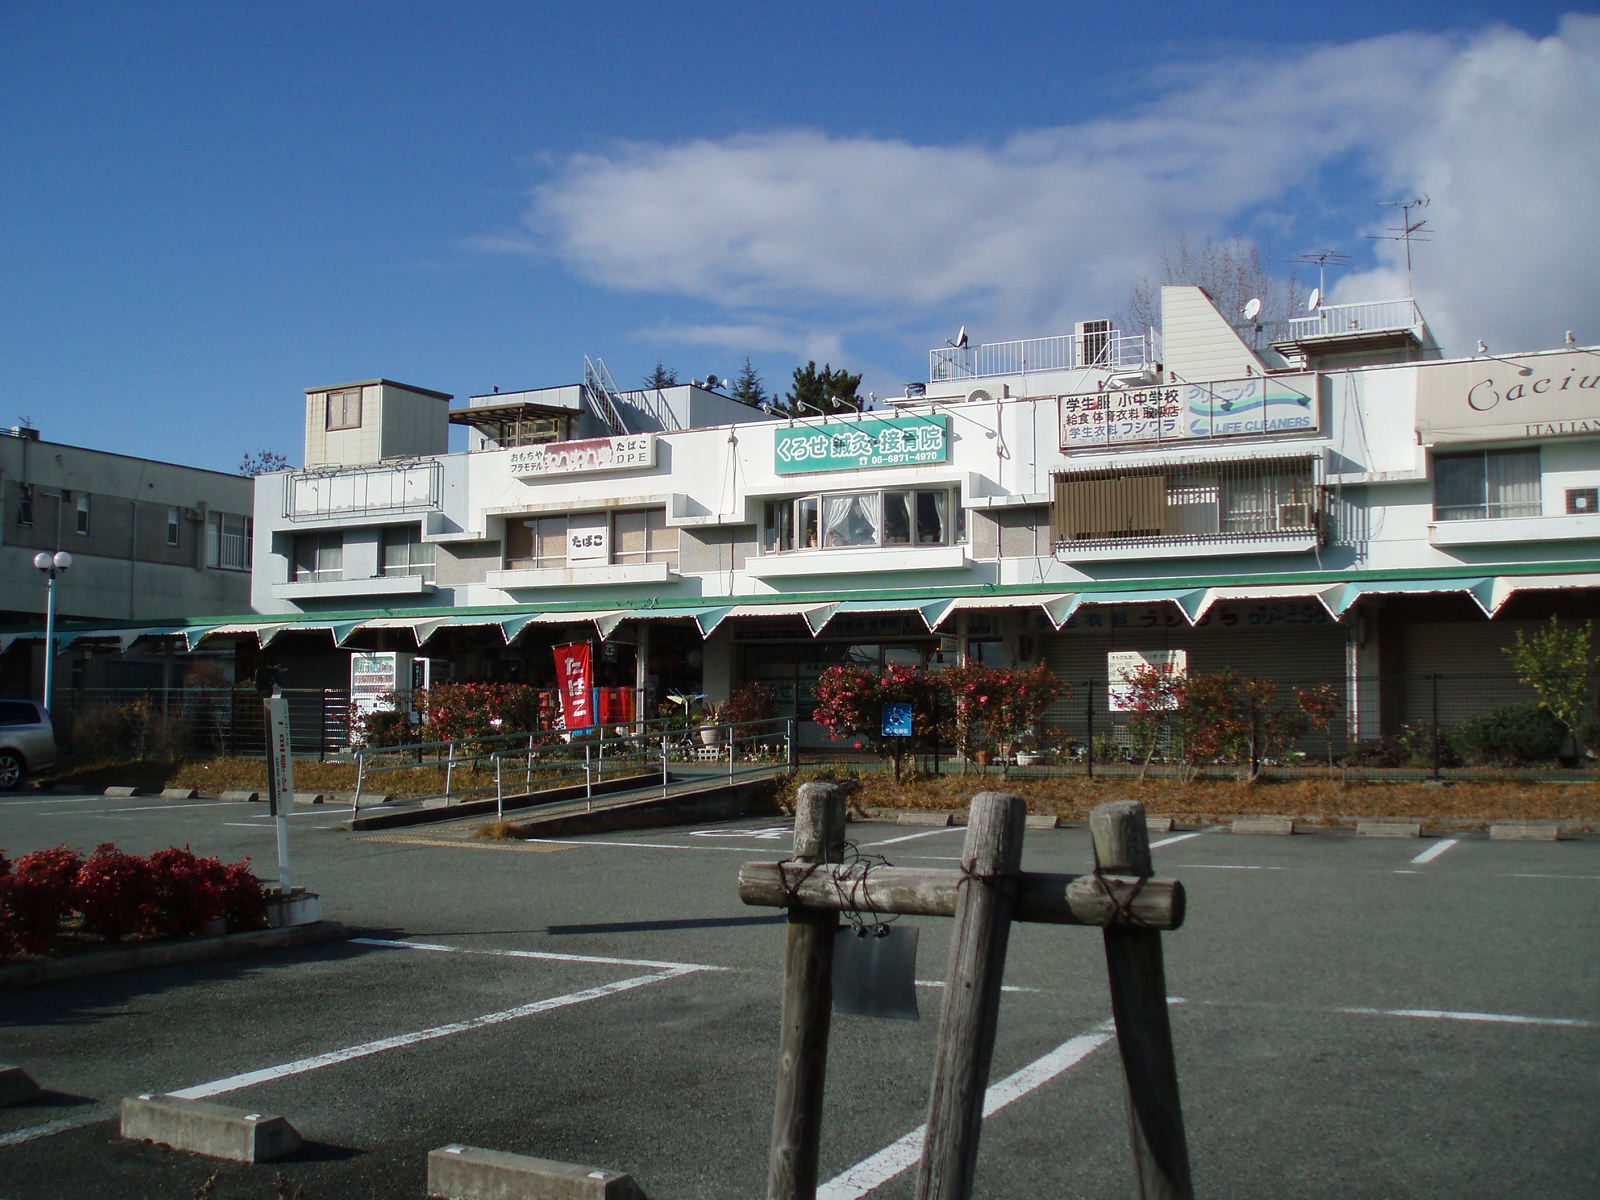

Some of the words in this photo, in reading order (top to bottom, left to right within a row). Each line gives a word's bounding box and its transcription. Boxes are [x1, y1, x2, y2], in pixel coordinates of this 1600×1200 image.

[1066, 394, 1111, 413] 学生服
[1118, 388, 1180, 408] 小中学校
[1066, 411, 1090, 427] 給食
[1215, 421, 1242, 435] LIFE
[1244, 415, 1311, 432] CLEANERS
[1069, 422, 1119, 440] 学生衣料
[1121, 418, 1177, 435] フジワラ
[616, 440, 647, 452] たばこ
[776, 435, 829, 463] くろせ
[871, 451, 938, 465] 06-6871-4970
[510, 462, 544, 473] プラモデル
[571, 534, 603, 548] たばこ
[564, 656, 588, 718] たばこ
